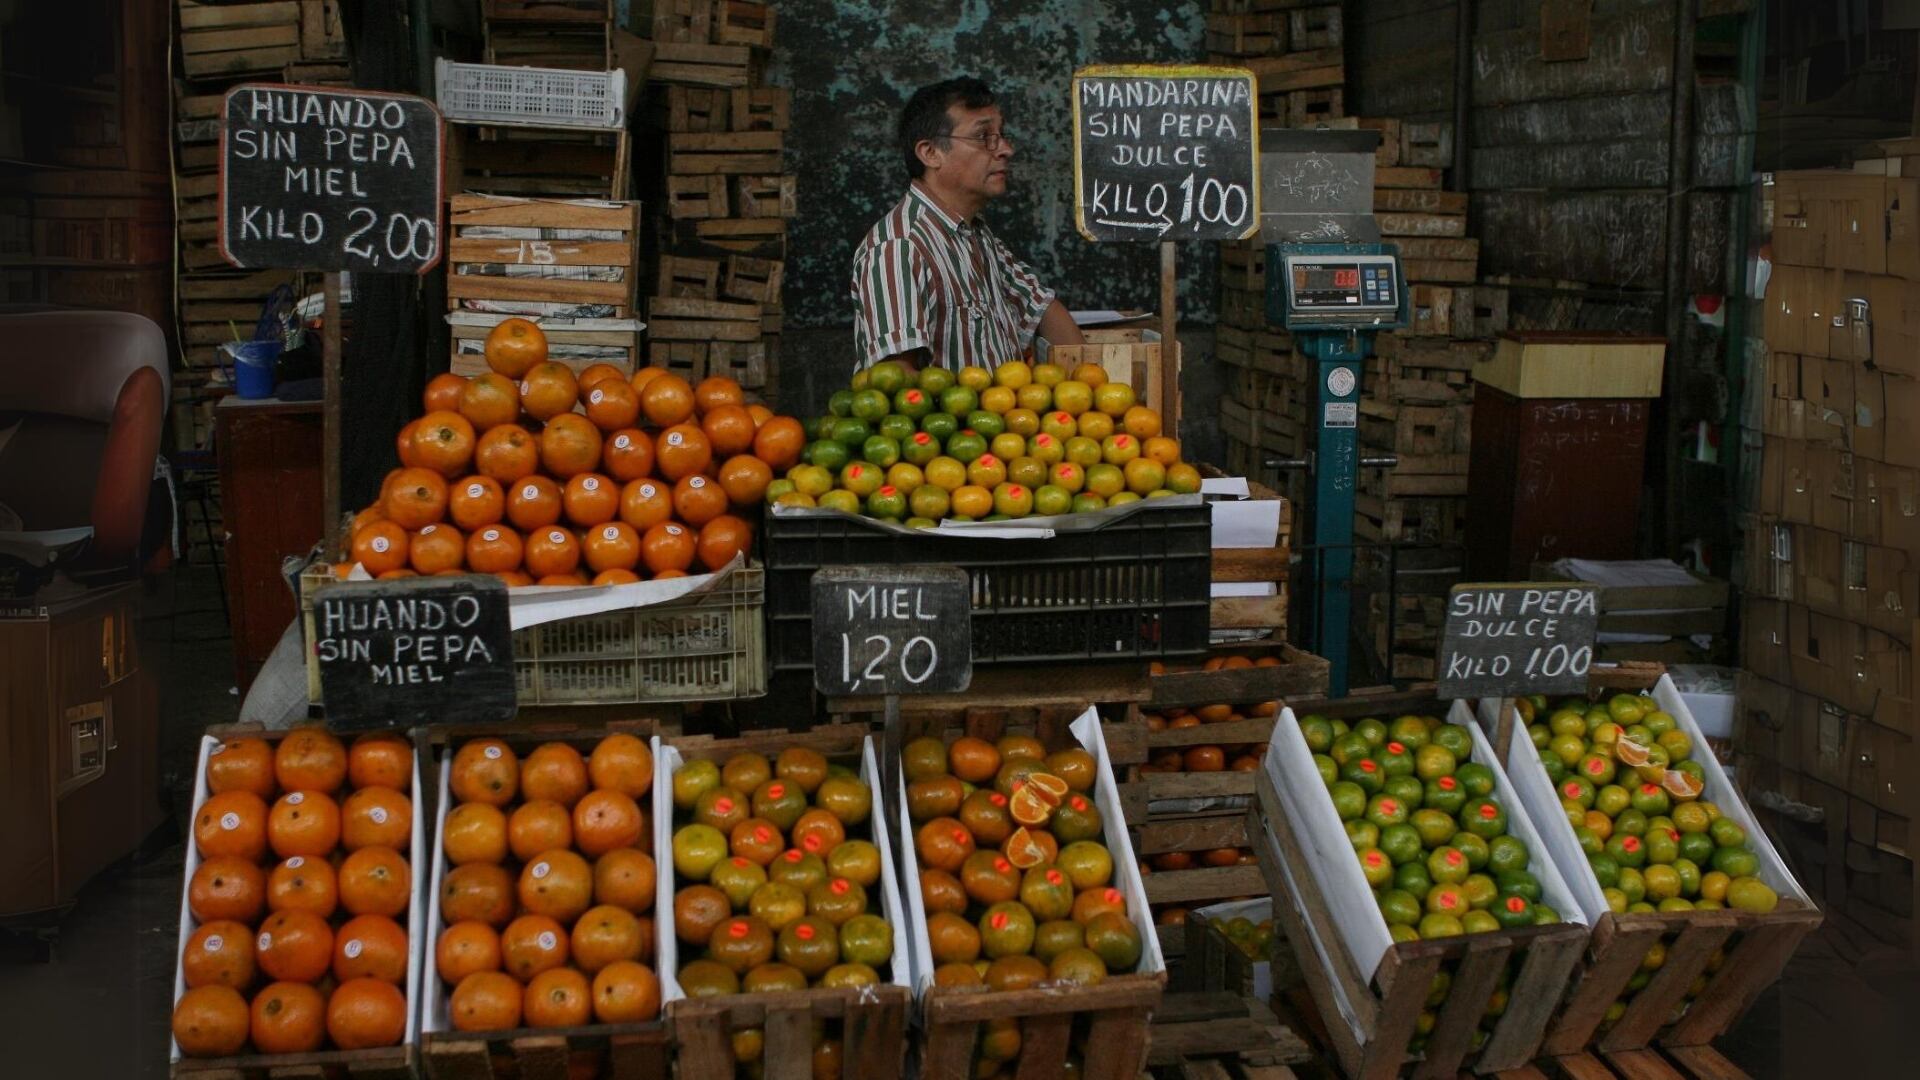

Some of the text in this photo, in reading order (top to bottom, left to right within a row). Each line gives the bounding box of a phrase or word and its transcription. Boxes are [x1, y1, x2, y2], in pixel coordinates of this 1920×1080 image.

[1083, 80, 1251, 107] MANDARINA
[251, 90, 406, 129] HUANDO
[1088, 112, 1237, 139] SIN PEPA
[234, 128, 297, 162] SIN
[323, 127, 416, 170] PEPA
[1111, 144, 1207, 168] DULCE
[284, 165, 368, 198] MIEL
[1092, 178, 1168, 217] KILO
[1179, 172, 1248, 233] 1,00
[240, 205, 435, 267] KILO 2,00
[324, 595, 480, 637] HUANDO
[848, 585, 938, 622] MIEL
[1451, 588, 1596, 617] SIN PEPA
[1460, 618, 1559, 639] DULCE
[319, 634, 493, 664] SIN PEPA
[841, 632, 938, 693] 1,20
[370, 664, 444, 686] MIEL
[1446, 650, 1512, 680] KILO
